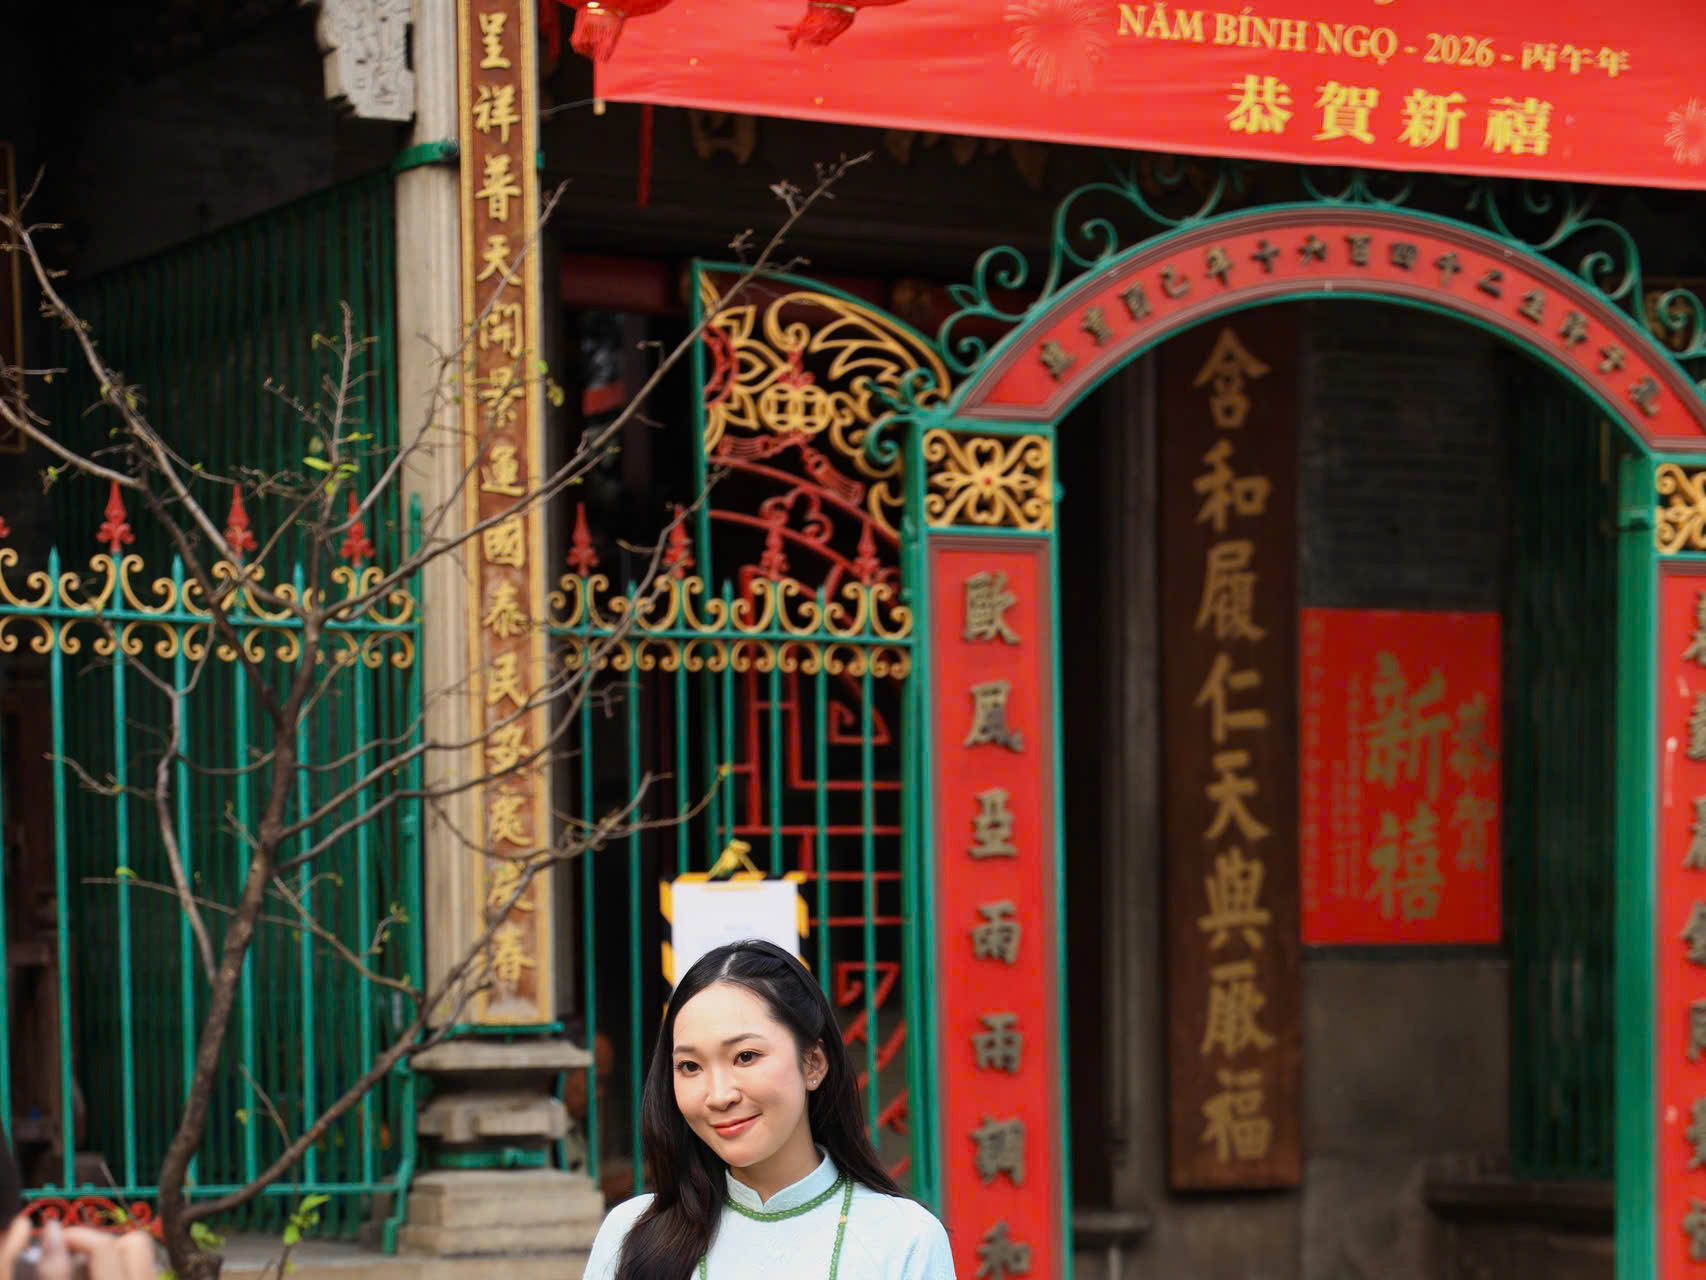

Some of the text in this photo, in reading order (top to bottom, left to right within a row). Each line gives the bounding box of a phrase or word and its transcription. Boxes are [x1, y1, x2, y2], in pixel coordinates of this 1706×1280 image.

[1118, 3, 1205, 43] NĂM
[1214, 6, 1308, 53] BÍNH
[1317, 24, 1398, 66] NGỌ
[1423, 33, 1496, 68] 2026
[1521, 41, 1632, 78] 丙午年
[1225, 74, 1554, 157] 恭賀新禧
[1365, 650, 1449, 922] 新禧
